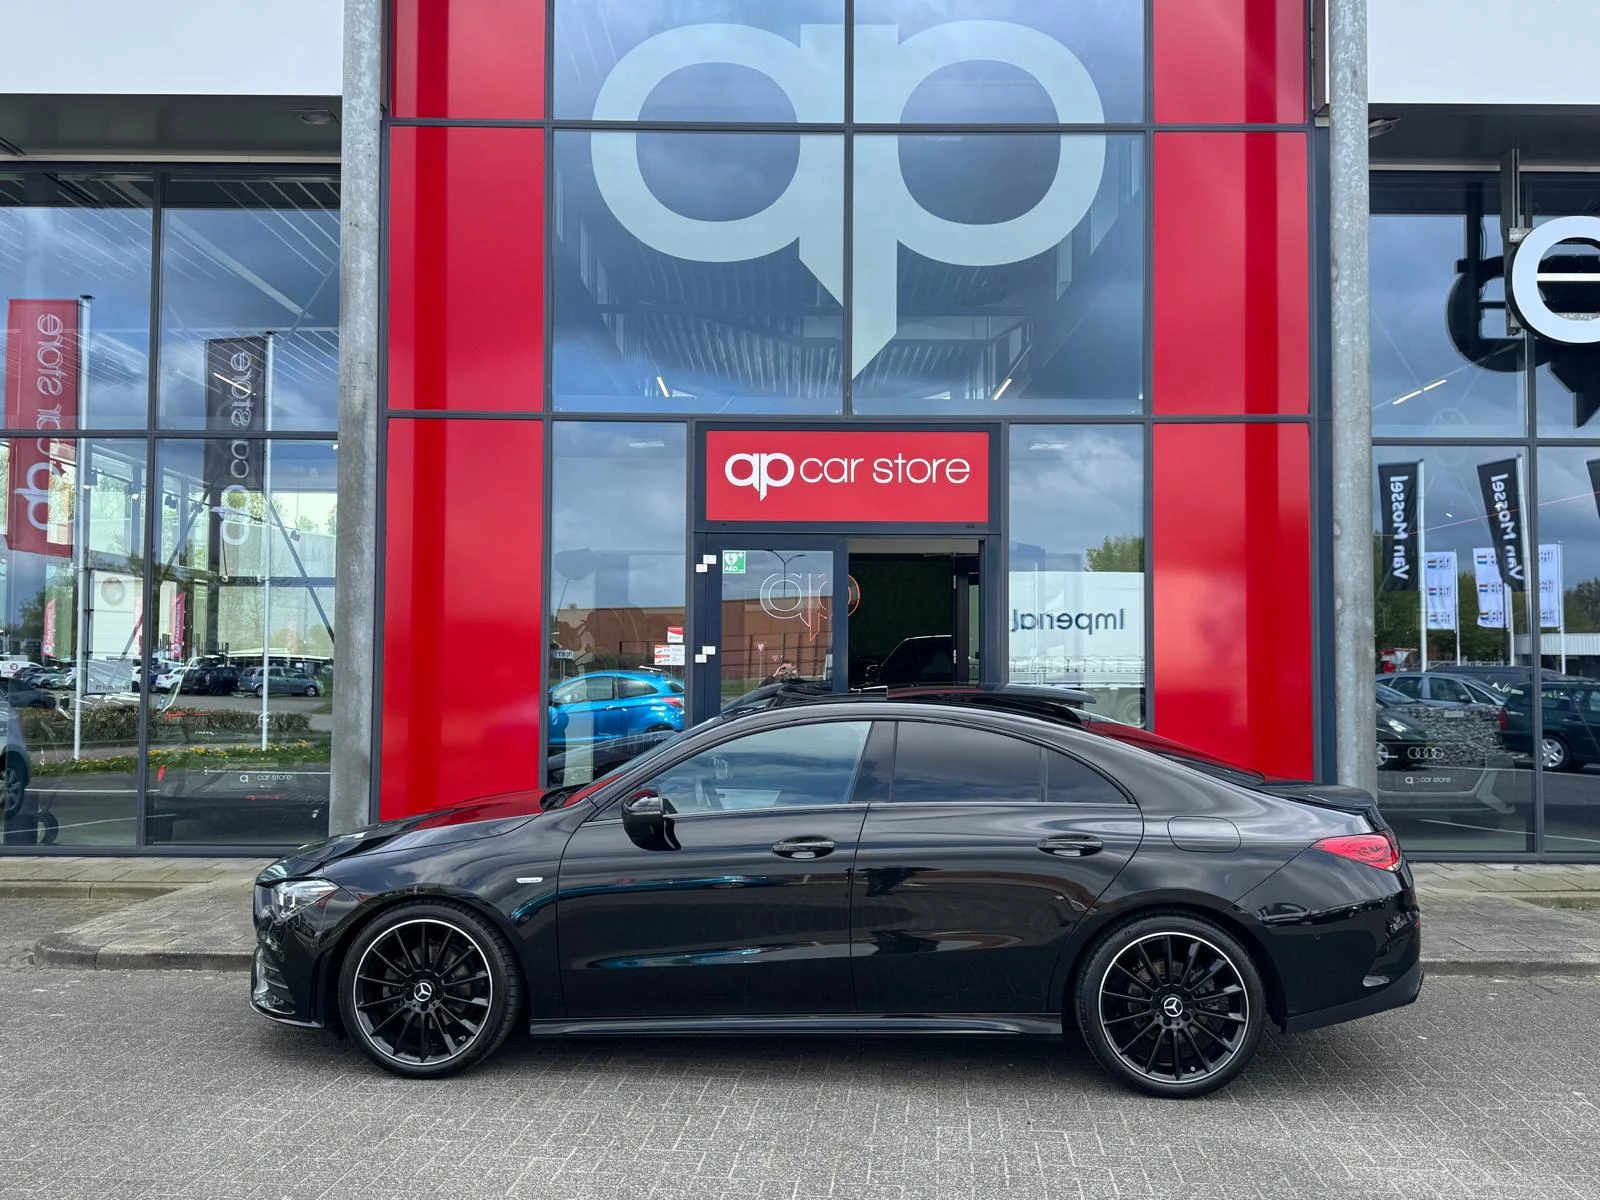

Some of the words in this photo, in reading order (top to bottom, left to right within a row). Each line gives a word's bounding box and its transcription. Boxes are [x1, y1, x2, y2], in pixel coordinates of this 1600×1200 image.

[591, 20, 1106, 380] ap
[725, 453, 795, 501] ap
[800, 457, 864, 483] car
[872, 453, 971, 484] store
